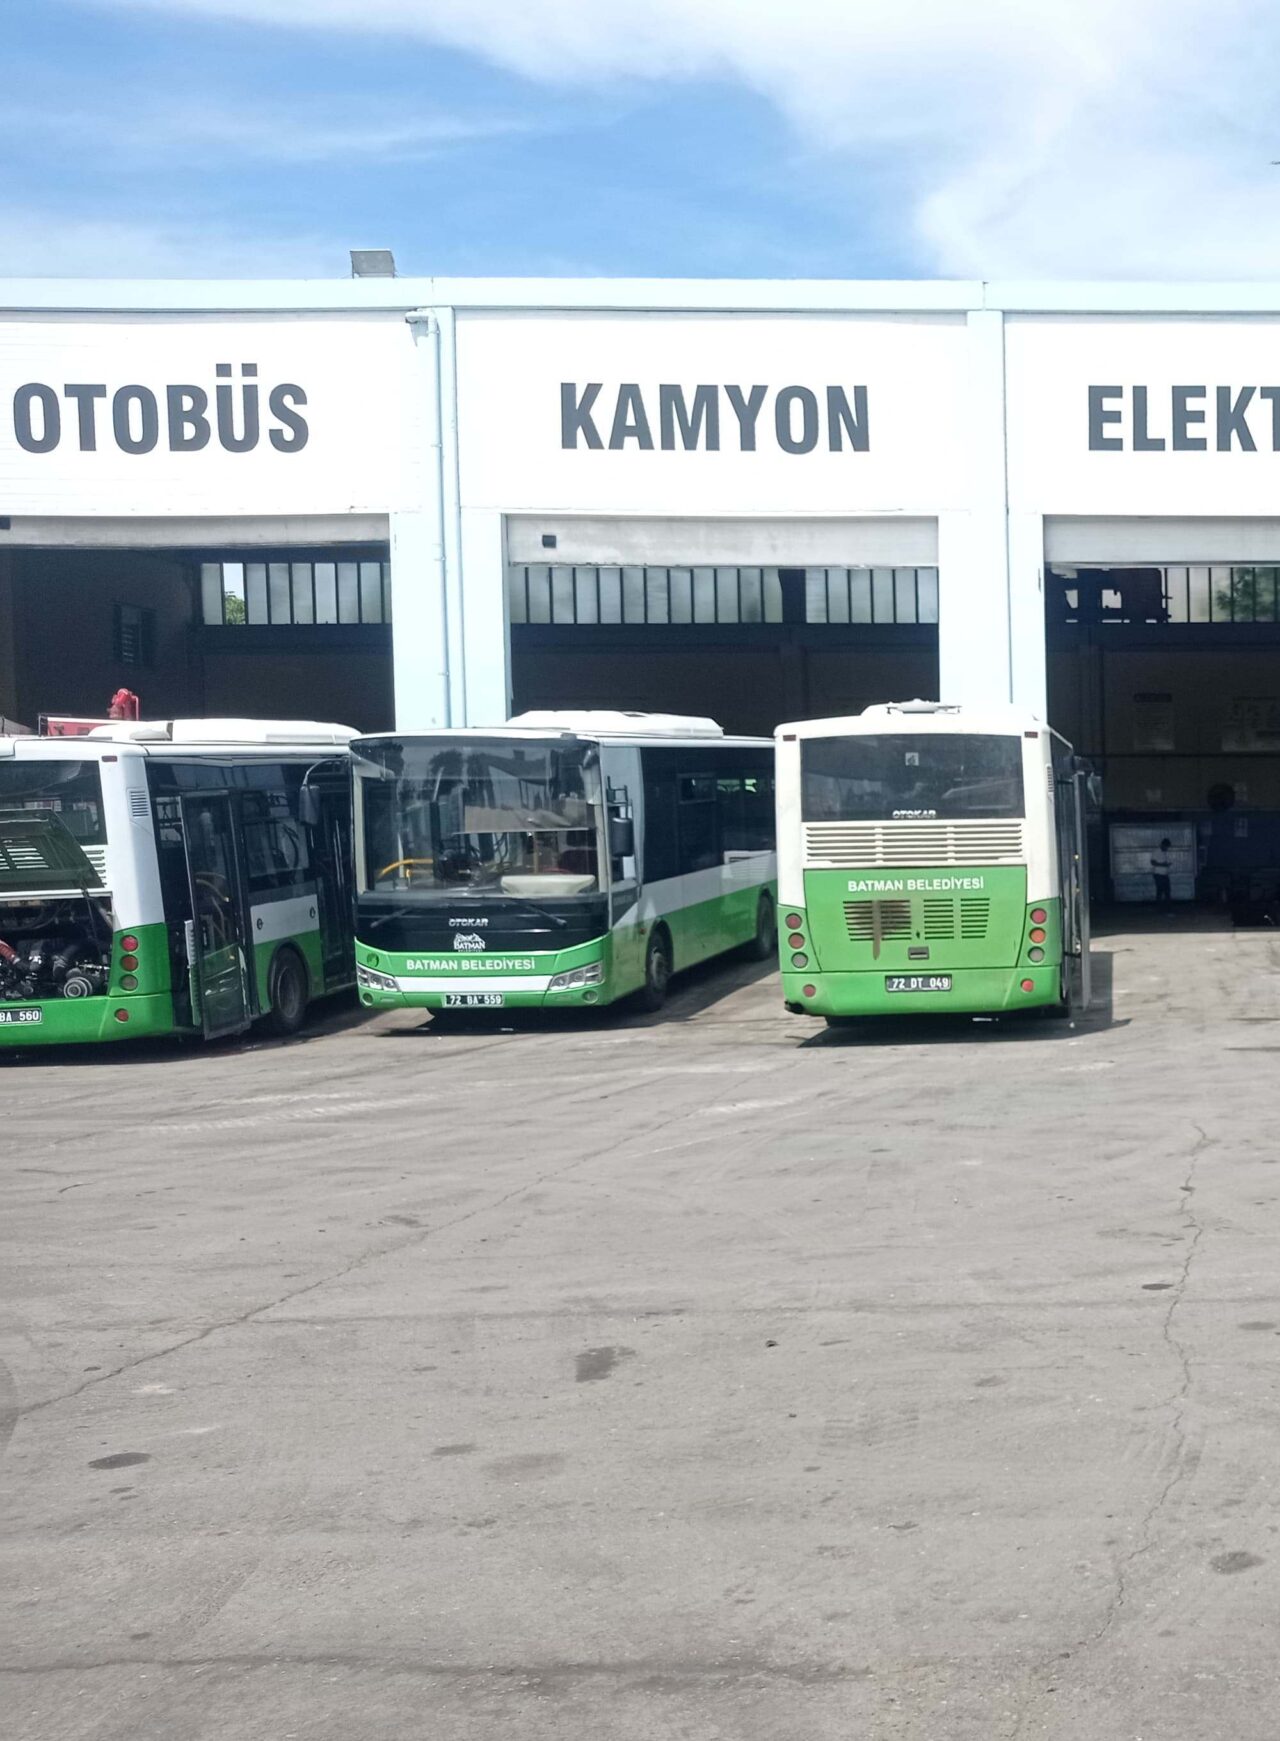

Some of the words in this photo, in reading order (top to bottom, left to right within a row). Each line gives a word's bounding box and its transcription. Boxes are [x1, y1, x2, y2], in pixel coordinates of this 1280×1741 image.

[13, 362, 310, 455] OTOBÜS
[560, 382, 870, 455] KAMYON
[892, 810, 937, 819] OTOKAR
[847, 880, 903, 892] BATMAN
[907, 876, 984, 891] BELEDİYESİ
[448, 918, 489, 927] OTOKAR
[406, 959, 458, 971] BATMAN
[461, 957, 535, 970] BELEDİYESİ
[892, 978, 905, 989] 72
[910, 977, 924, 989] DT
[929, 977, 949, 988] 049
[450, 995, 462, 1005] 72
[19, 1010, 39, 1021] 560
